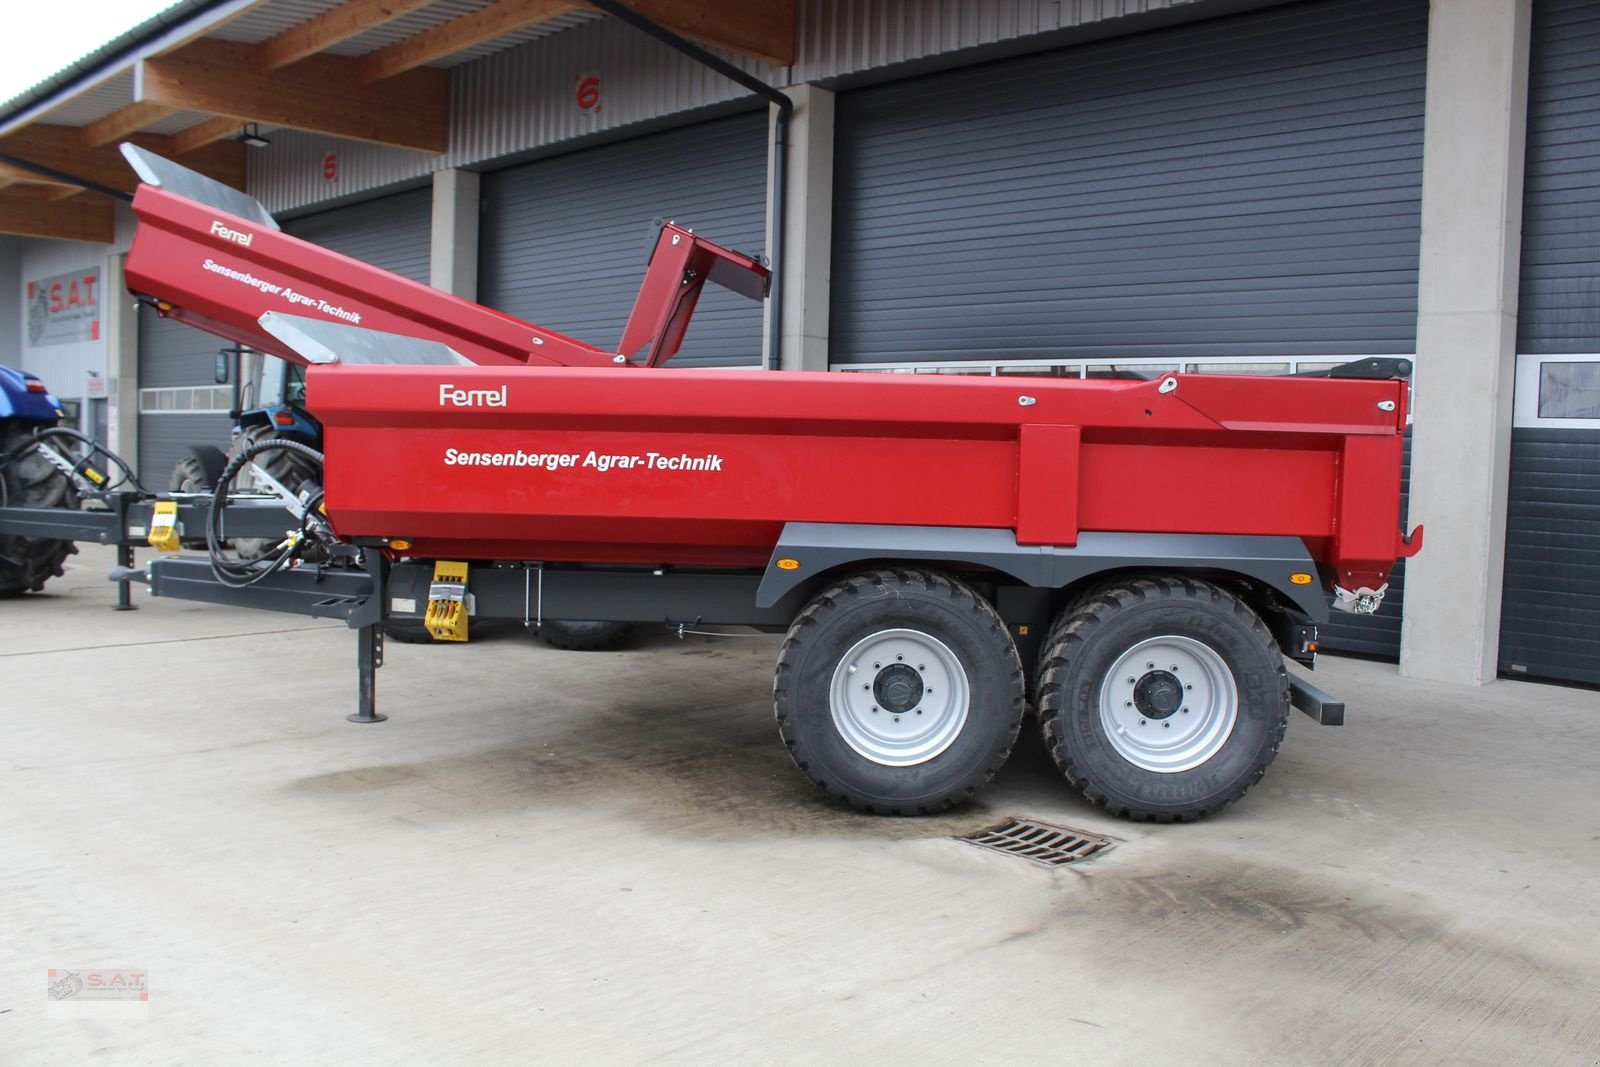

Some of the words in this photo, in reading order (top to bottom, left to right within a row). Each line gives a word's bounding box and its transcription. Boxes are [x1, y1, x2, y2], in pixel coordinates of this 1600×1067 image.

[576, 76, 600, 109] 6
[323, 155, 337, 180] 5
[210, 221, 253, 246] Ferrel
[202, 259, 282, 293] Sensenberger
[281, 288, 362, 324] Agrar-Technik
[439, 384, 507, 407] Ferrel
[444, 448, 580, 471] Sensenberger
[582, 451, 723, 471] Agrar-Technik
